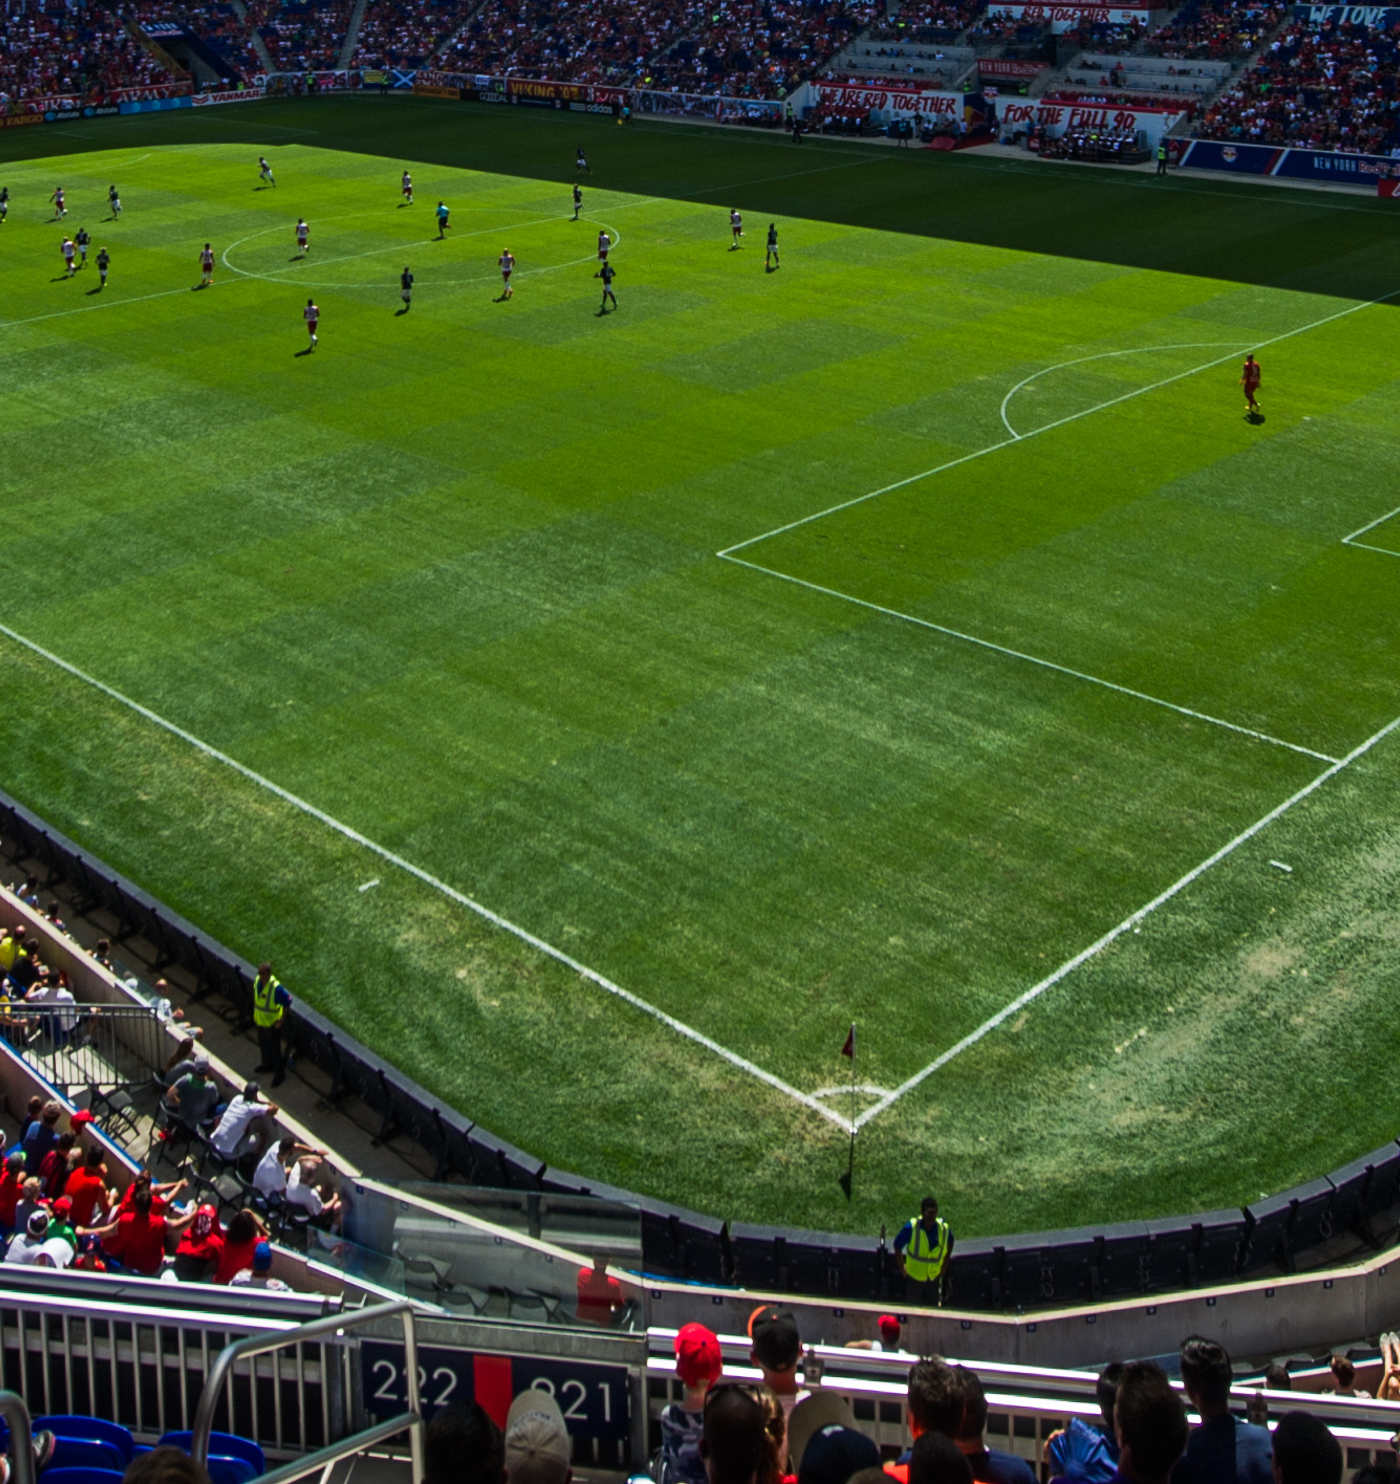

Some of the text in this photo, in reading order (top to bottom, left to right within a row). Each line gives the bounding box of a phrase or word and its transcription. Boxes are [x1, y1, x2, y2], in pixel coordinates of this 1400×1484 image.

[1048, 7, 1111, 22] TOGETHER
[1310, 6, 1335, 23] WE
[210, 90, 260, 103] YANMAR
[822, 87, 956, 115] WE ARE RED TOGETHER
[586, 103, 613, 114] adidas
[1004, 104, 1137, 129] FOR THE FULL 90
[6, 114, 43, 127] FARGO
[1313, 156, 1357, 172] NEW YORK
[530, 1377, 612, 1423] 21
